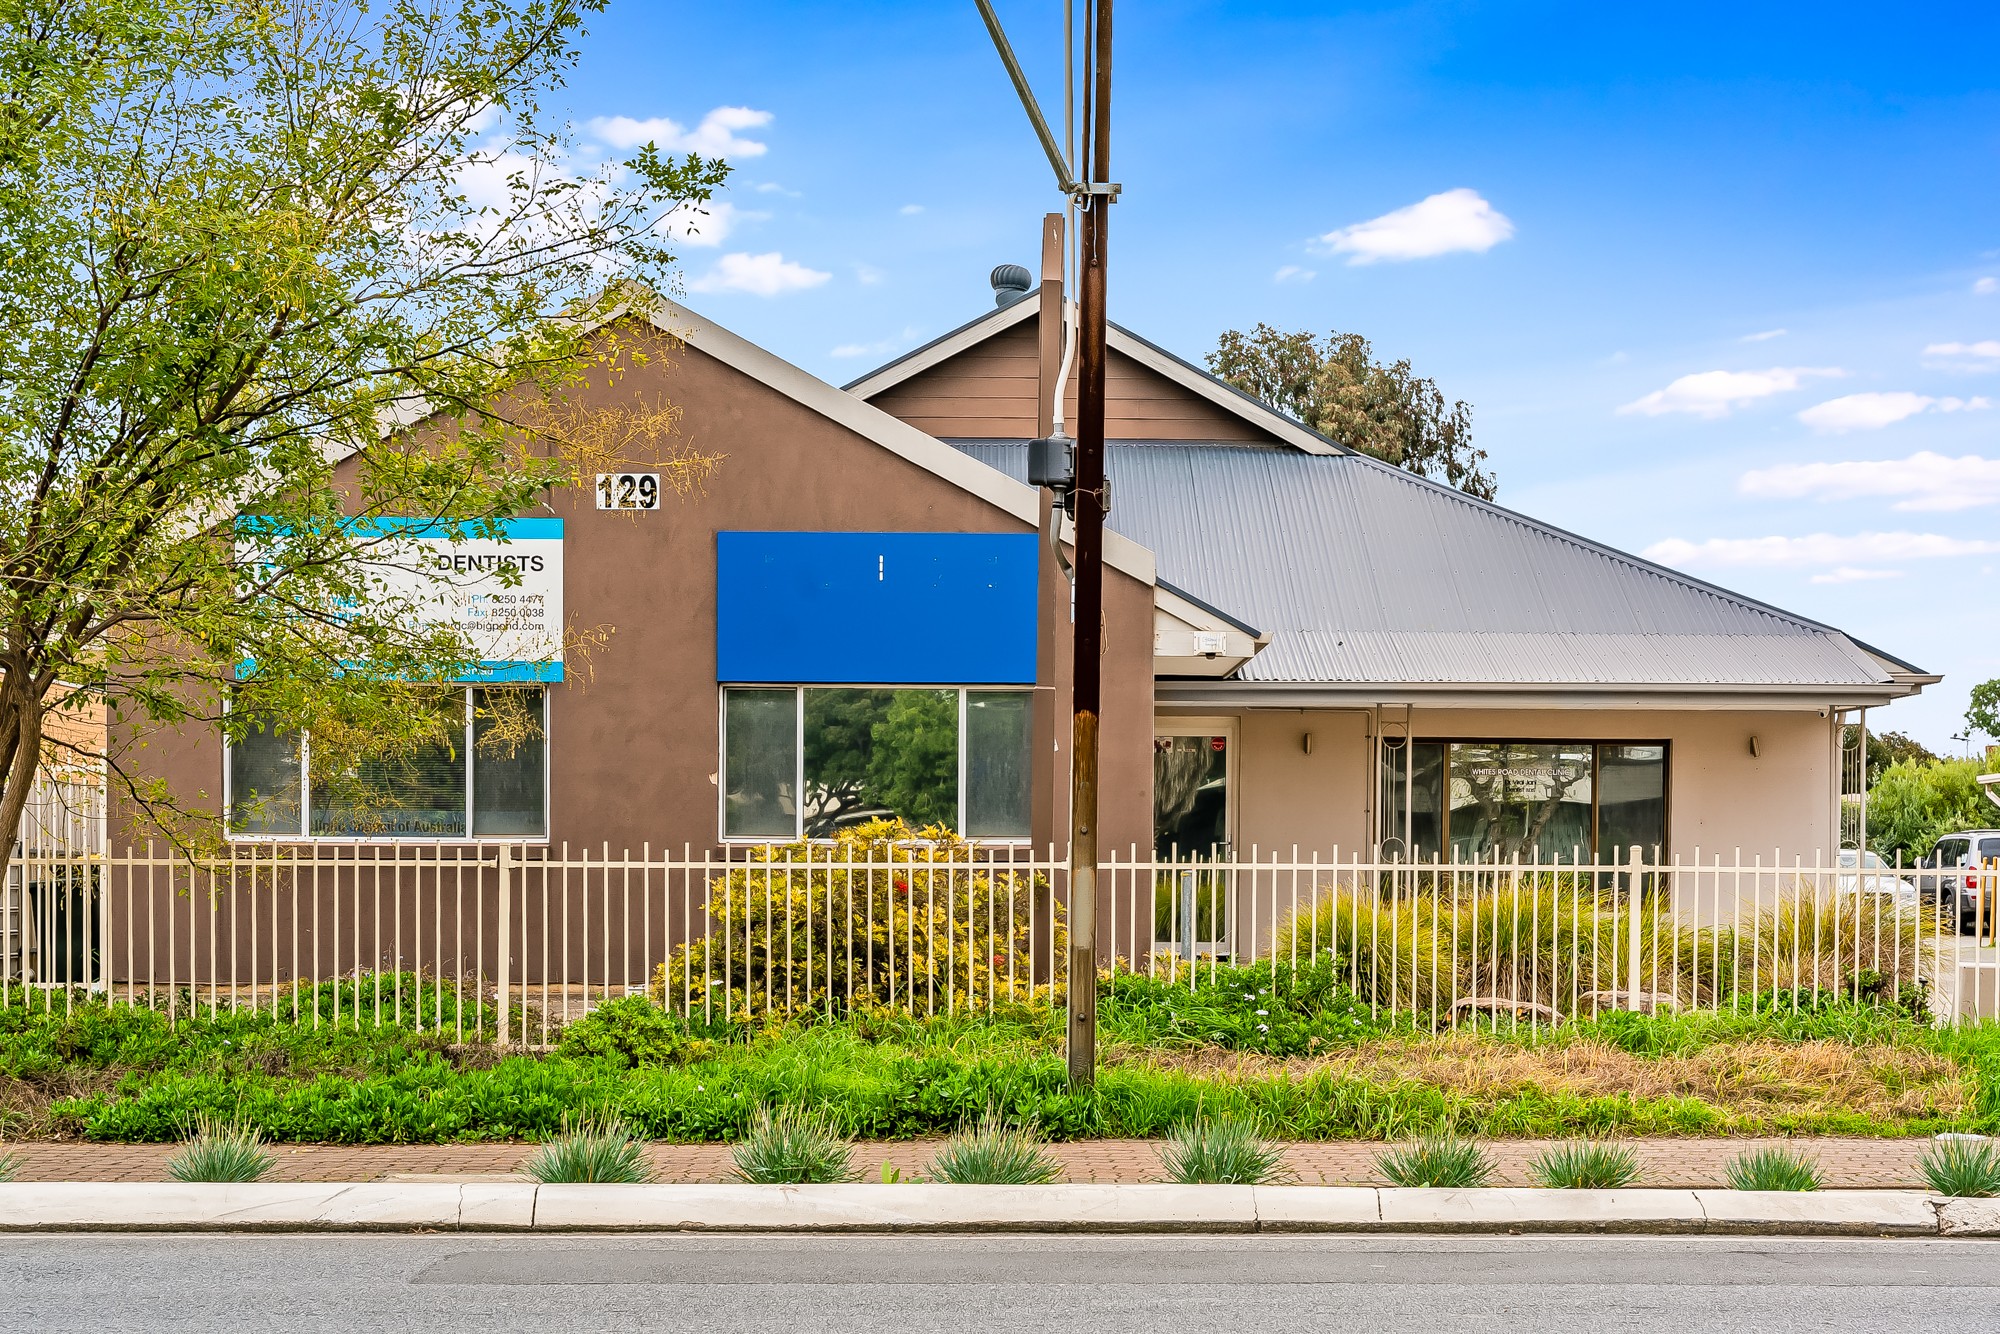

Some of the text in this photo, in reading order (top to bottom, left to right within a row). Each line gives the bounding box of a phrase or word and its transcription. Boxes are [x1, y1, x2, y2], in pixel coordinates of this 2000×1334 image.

[597, 474, 657, 508] 129
[437, 554, 544, 572] DENTISTS
[491, 594, 516, 604] 8250
[520, 594, 544, 604] 4477
[491, 608, 516, 617] 8250
[519, 608, 544, 617] 0038
[1547, 768, 1570, 776] CLINIC
[397, 820, 410, 832] of
